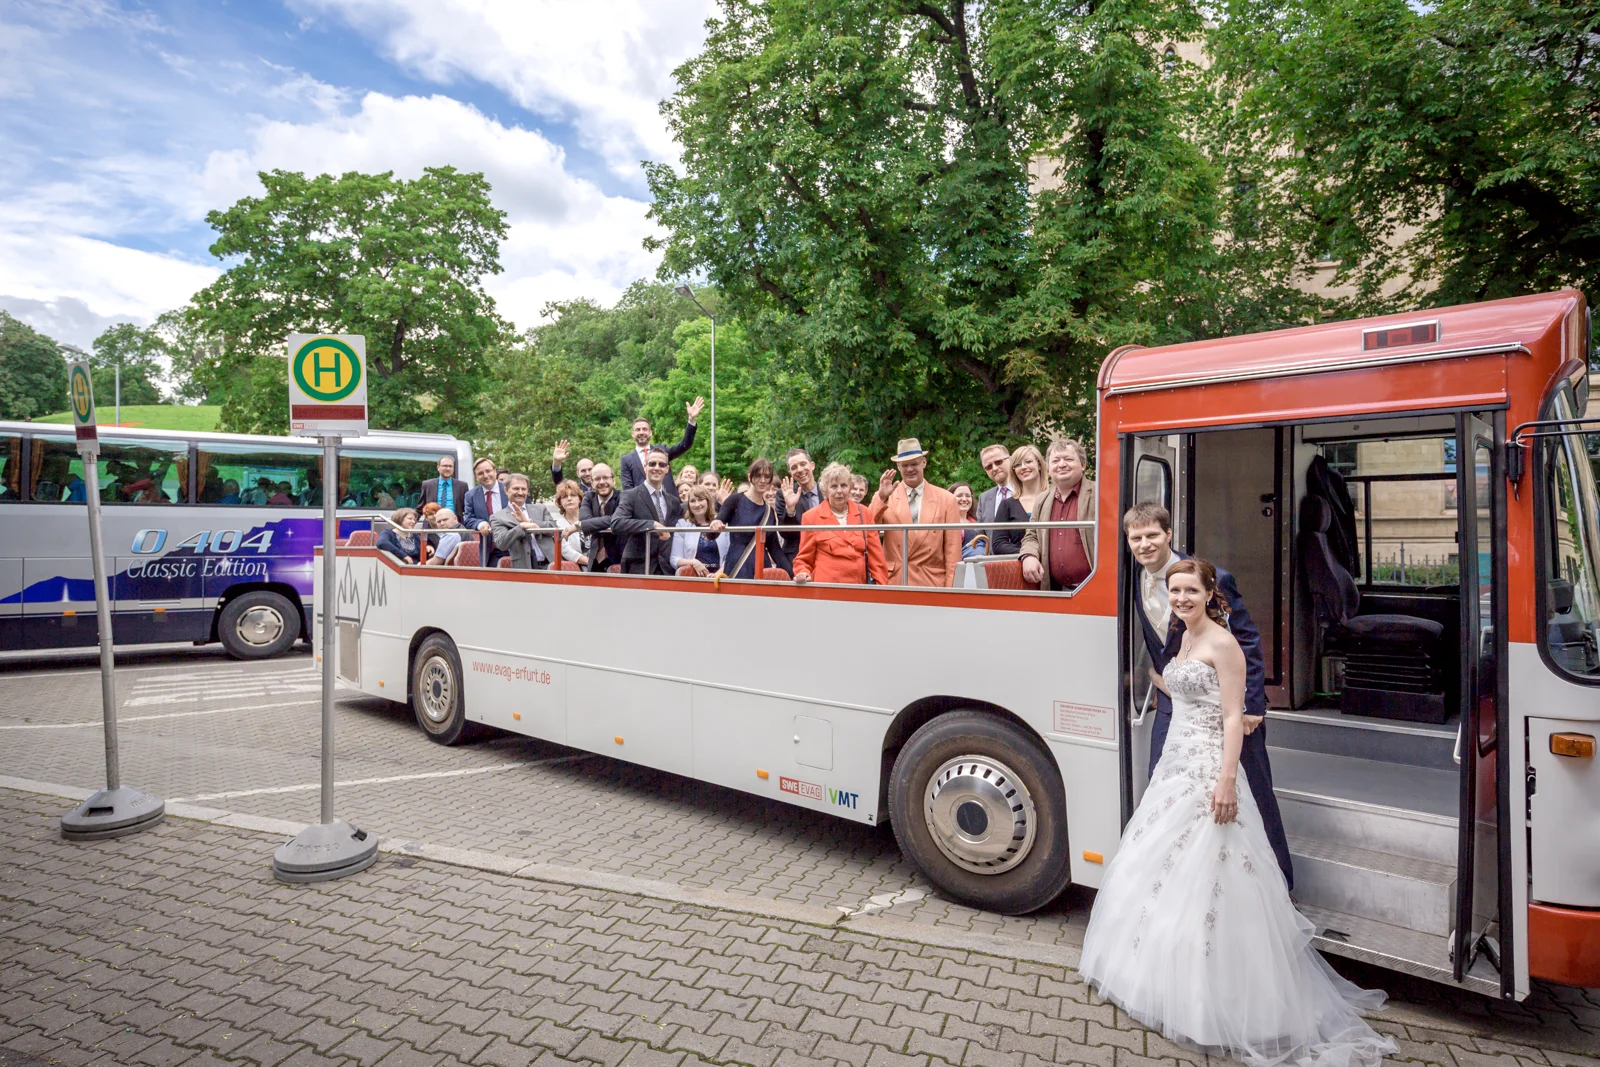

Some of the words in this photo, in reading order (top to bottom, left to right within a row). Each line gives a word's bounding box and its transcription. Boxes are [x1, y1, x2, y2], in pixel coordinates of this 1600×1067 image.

[314, 352, 341, 387] H
[175, 529, 274, 554] 404
[127, 558, 197, 578] Classic
[203, 558, 267, 577] Edition
[472, 661, 551, 685] www.evag-erfurt.de
[781, 779, 798, 792] SWE
[800, 783, 821, 798] EVAG
[829, 787, 859, 809] VMT
